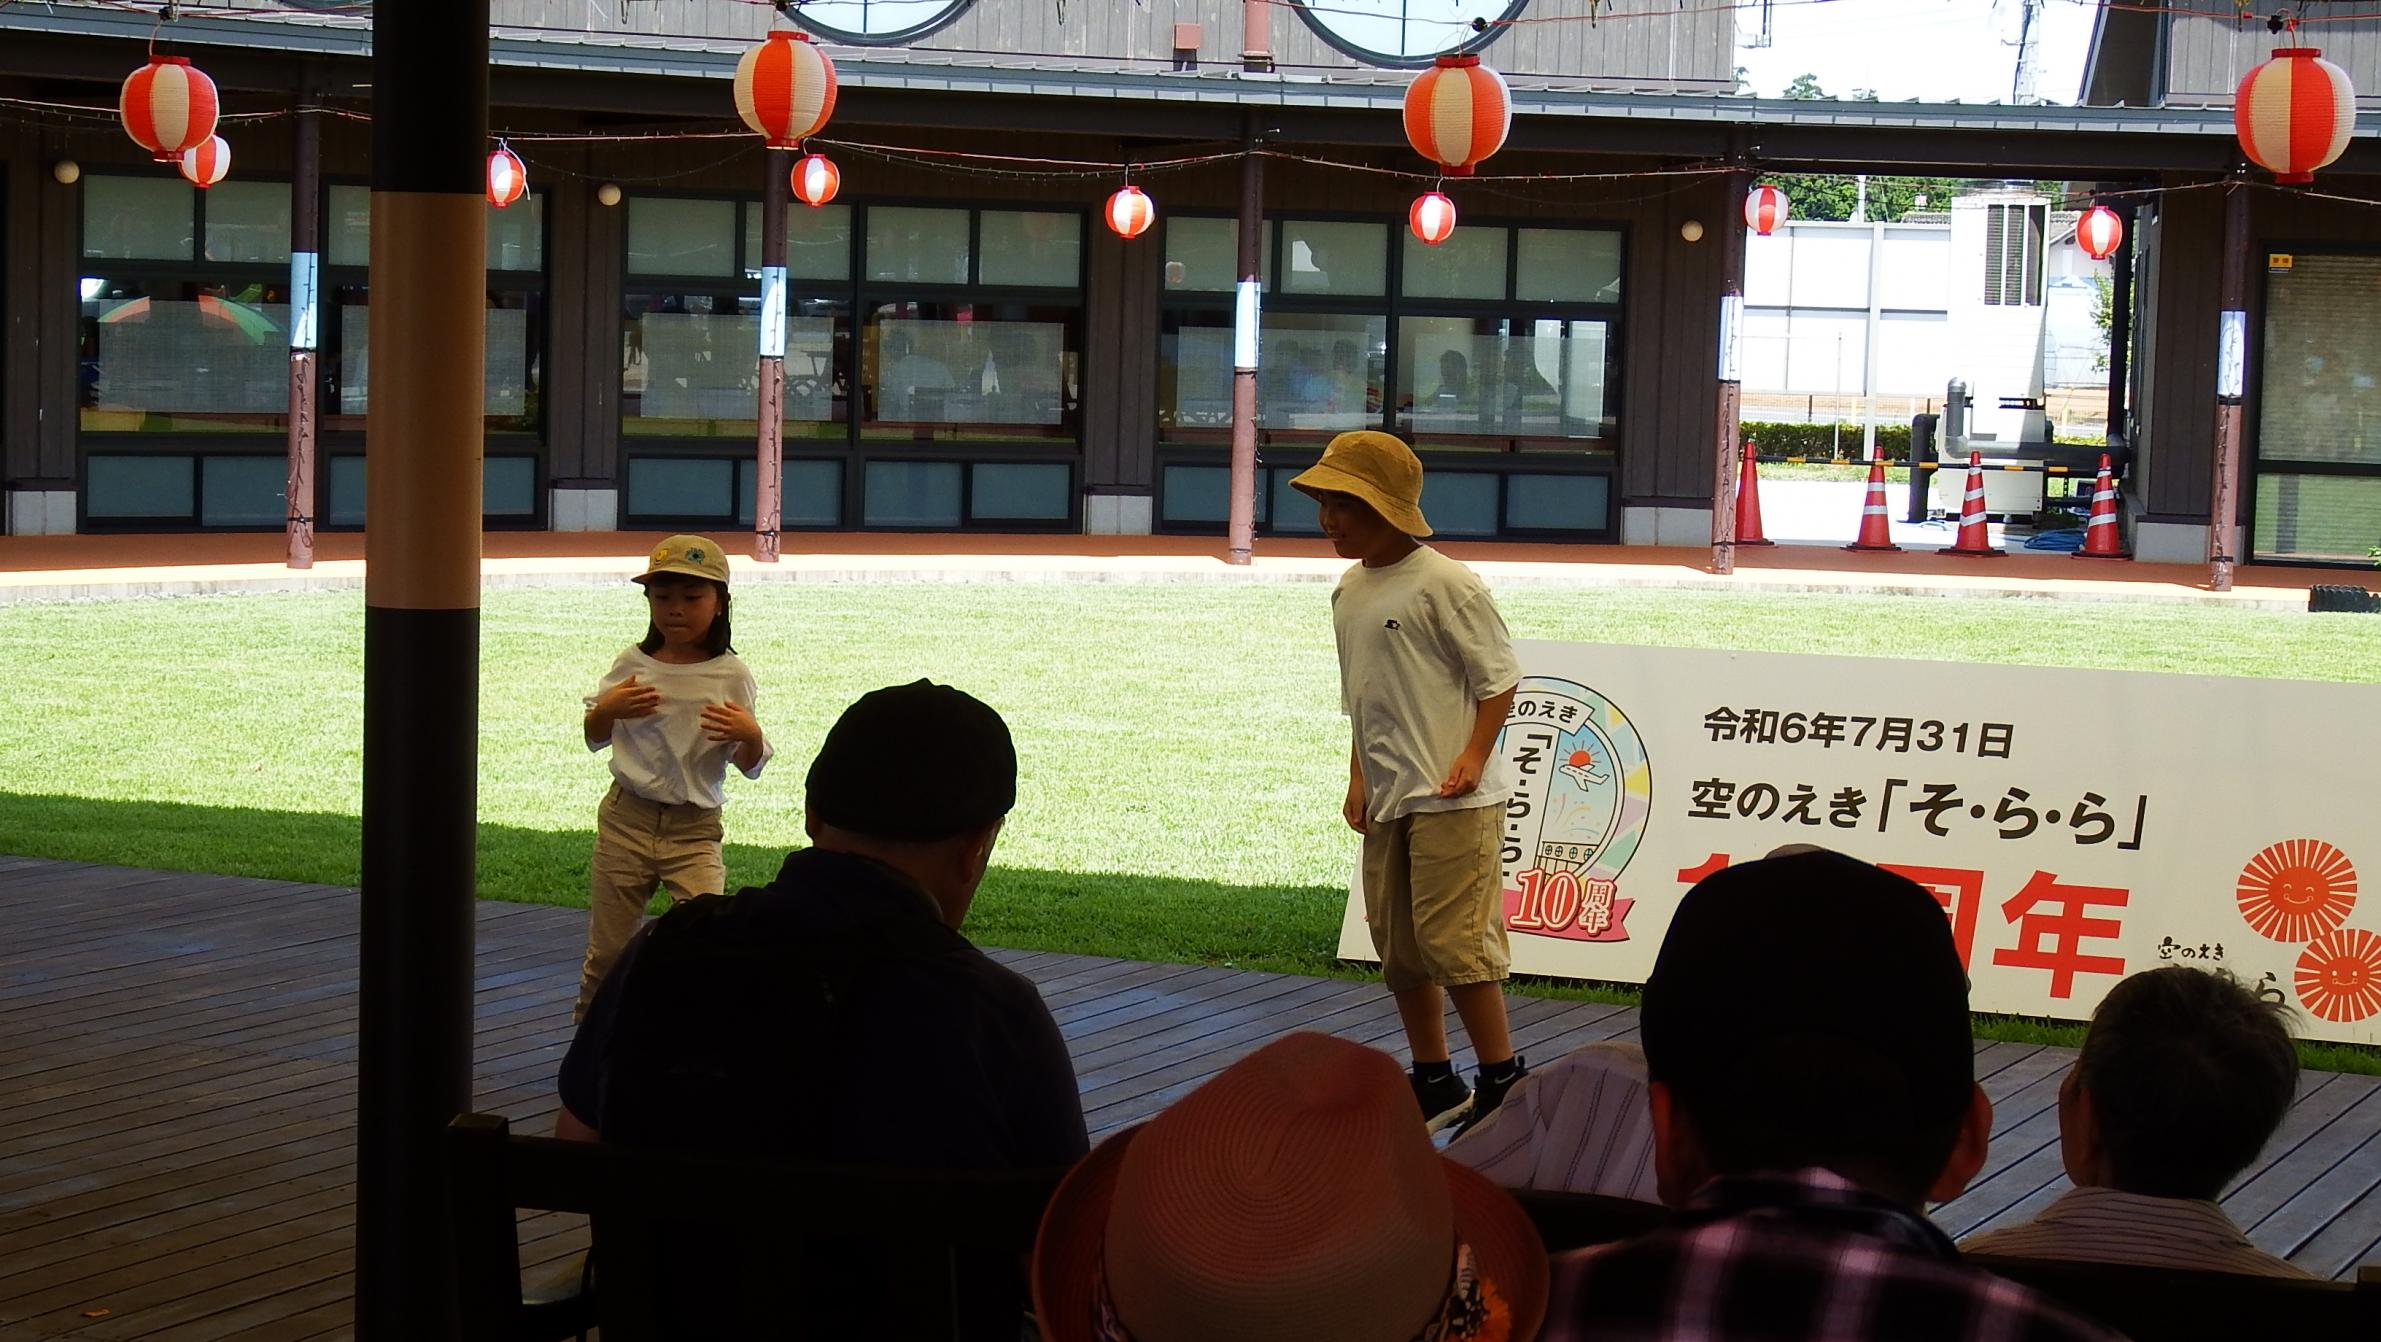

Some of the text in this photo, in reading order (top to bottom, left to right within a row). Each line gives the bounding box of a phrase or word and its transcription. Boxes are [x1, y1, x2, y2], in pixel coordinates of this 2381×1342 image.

[1703, 706, 2014, 759] 令和6年7月31日
[1502, 733, 1553, 877] 「そ・ら・ら
[1687, 777, 2148, 851] 空のえき「そ・ら・ら」
[2157, 936, 2225, 961] 空のえき
